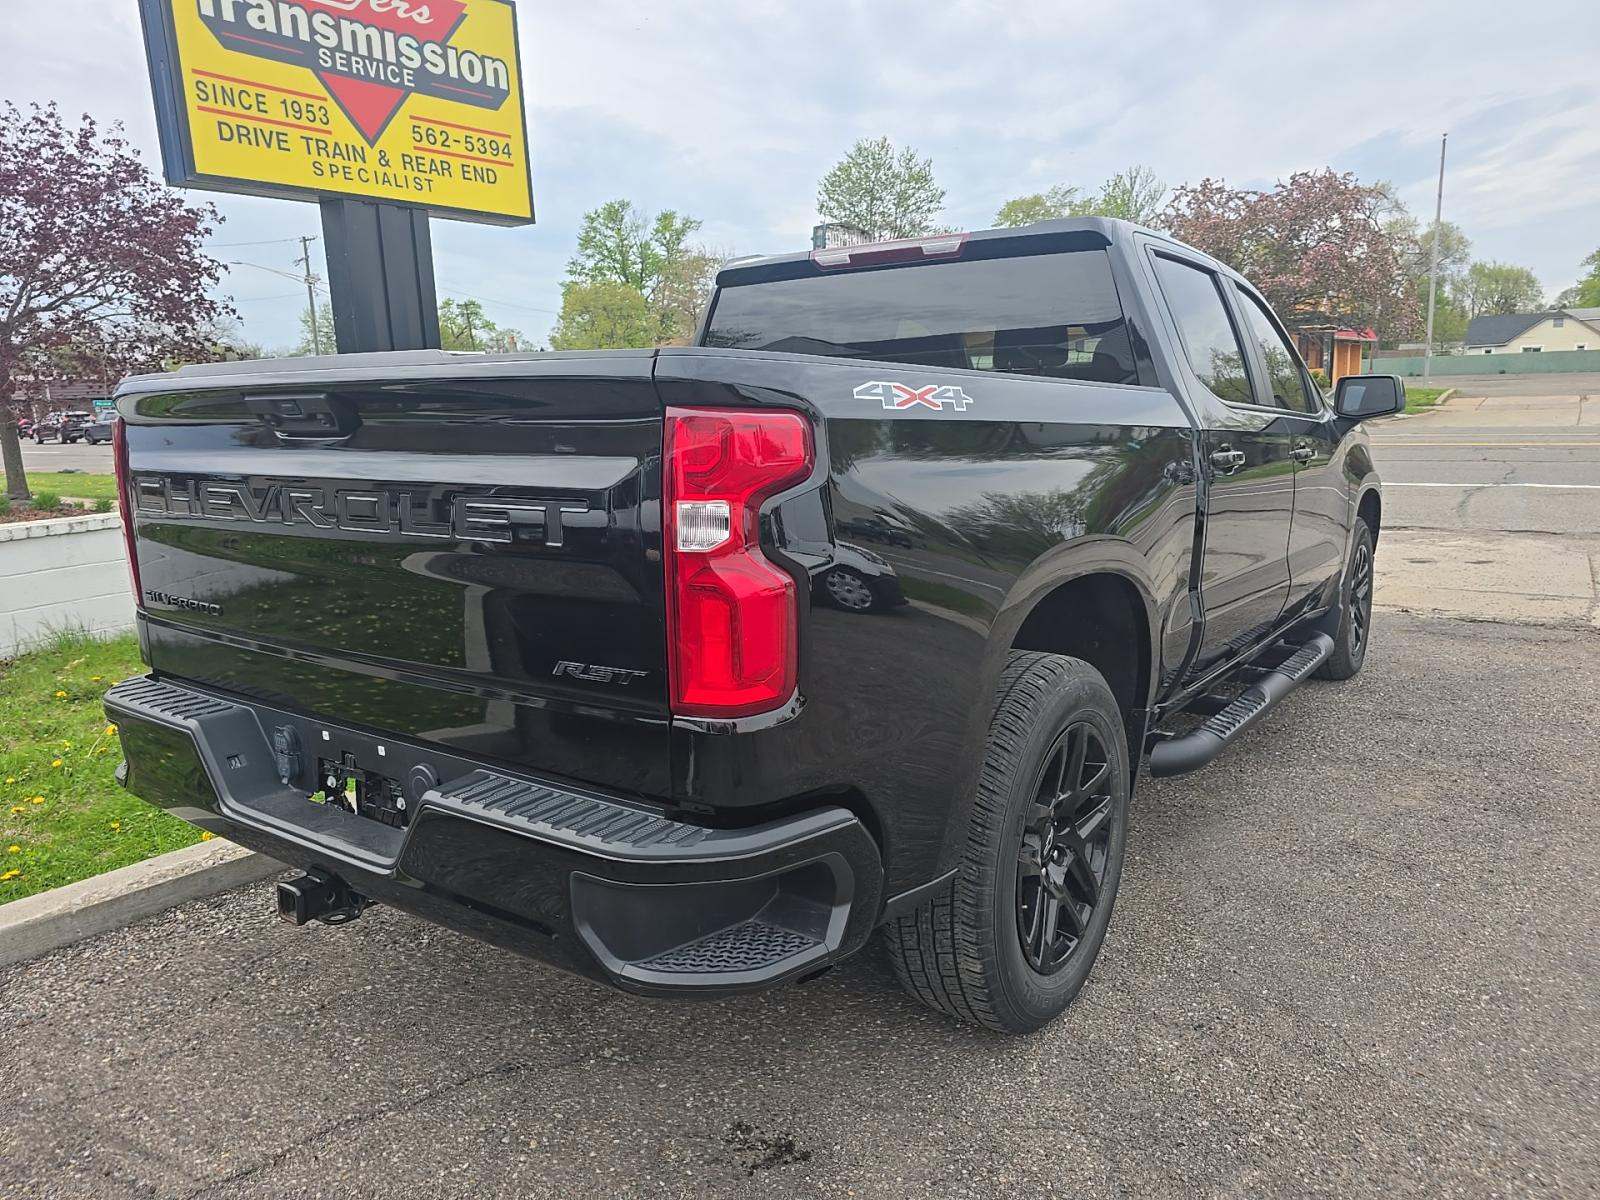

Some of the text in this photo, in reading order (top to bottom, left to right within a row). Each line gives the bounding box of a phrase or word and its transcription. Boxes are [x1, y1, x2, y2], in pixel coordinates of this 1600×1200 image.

[318, 48, 416, 88] SERVICE
[195, 80, 330, 126] SINCE 1953
[217, 120, 498, 185] DRIVE TRAIN & REAR END
[411, 124, 513, 160] 562-5394
[312, 160, 434, 193] SPECIALIST
[133, 476, 590, 547] CHEVROLET
[145, 590, 223, 617] SILVERADO
[551, 660, 648, 685] RST
